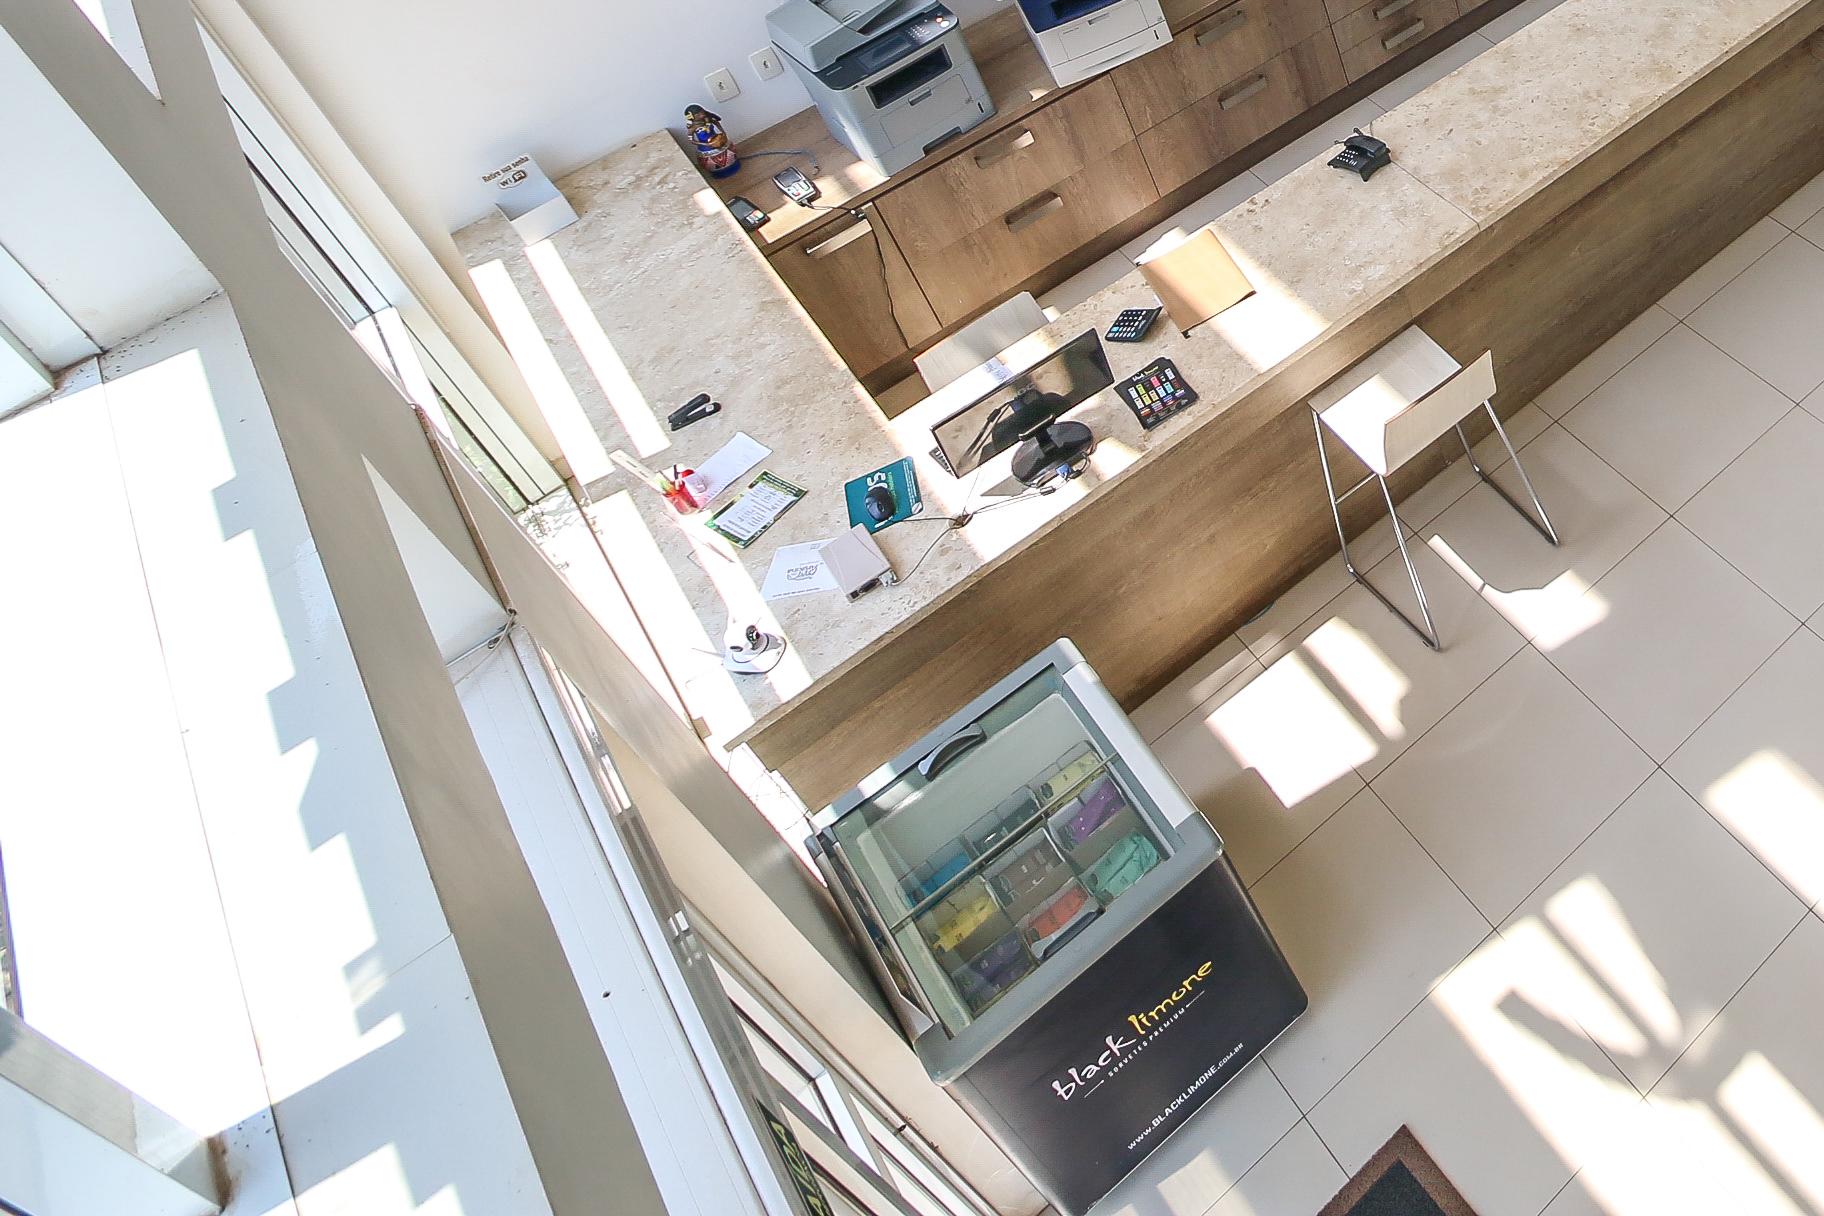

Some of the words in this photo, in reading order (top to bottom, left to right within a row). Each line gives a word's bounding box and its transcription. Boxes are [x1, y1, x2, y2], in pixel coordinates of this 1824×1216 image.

[481, 170, 501, 183] Retire
[501, 165, 513, 174] sua
[511, 156, 530, 169] senha
[1051, 1035, 1137, 1103] black
[1127, 960, 1213, 1035] limone
[1108, 1041, 1148, 1077] SORVETES
[1148, 1008, 1186, 1041] PREMIUM
